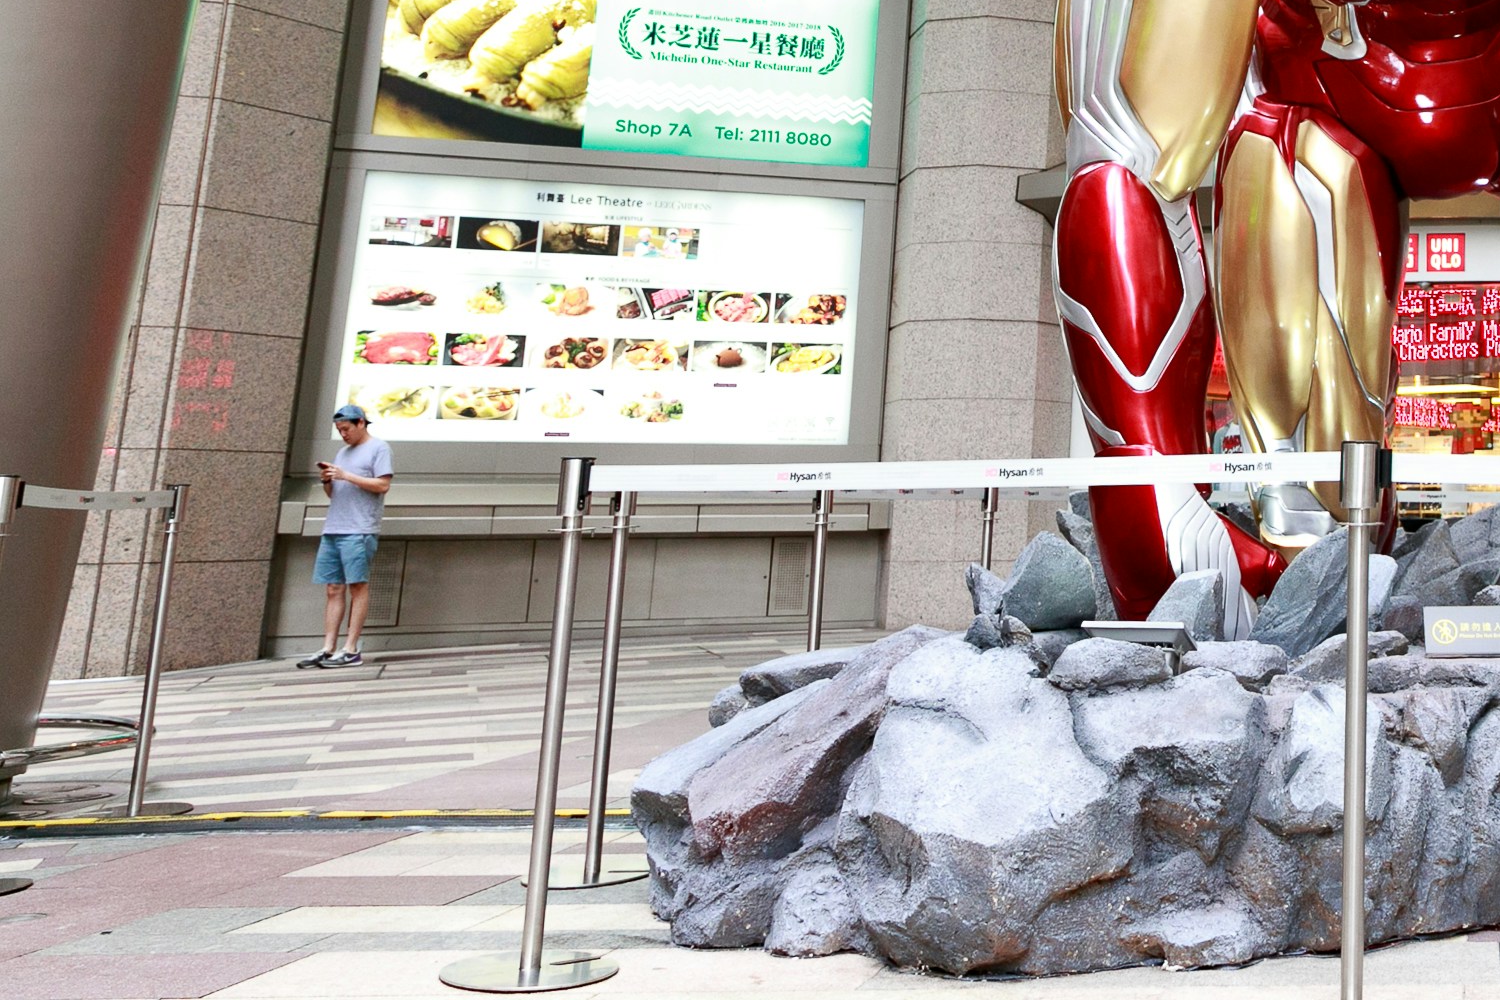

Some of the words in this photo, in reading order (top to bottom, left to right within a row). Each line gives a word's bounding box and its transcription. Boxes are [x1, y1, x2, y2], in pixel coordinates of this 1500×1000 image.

[641, 21, 825, 60] 米芝蓮一星餐廳
[649, 50, 698, 64] Michelin
[701, 55, 750, 69] One-Star
[754, 60, 812, 74] Restaurant
[615, 119, 662, 137] Shop
[668, 123, 692, 138] 7A
[715, 126, 743, 141] Tel:
[749, 129, 780, 143] 2111
[786, 132, 832, 147] 8080
[570, 194, 592, 205] Lee
[597, 195, 643, 208] Theatre
[1430, 238, 1459, 253] UNI
[1430, 253, 1462, 270] QLO
[1400, 342, 1479, 361] Characters
[999, 468, 1027, 479] Hysan
[1224, 462, 1255, 473] Hysan
[790, 472, 816, 482] Hysan
